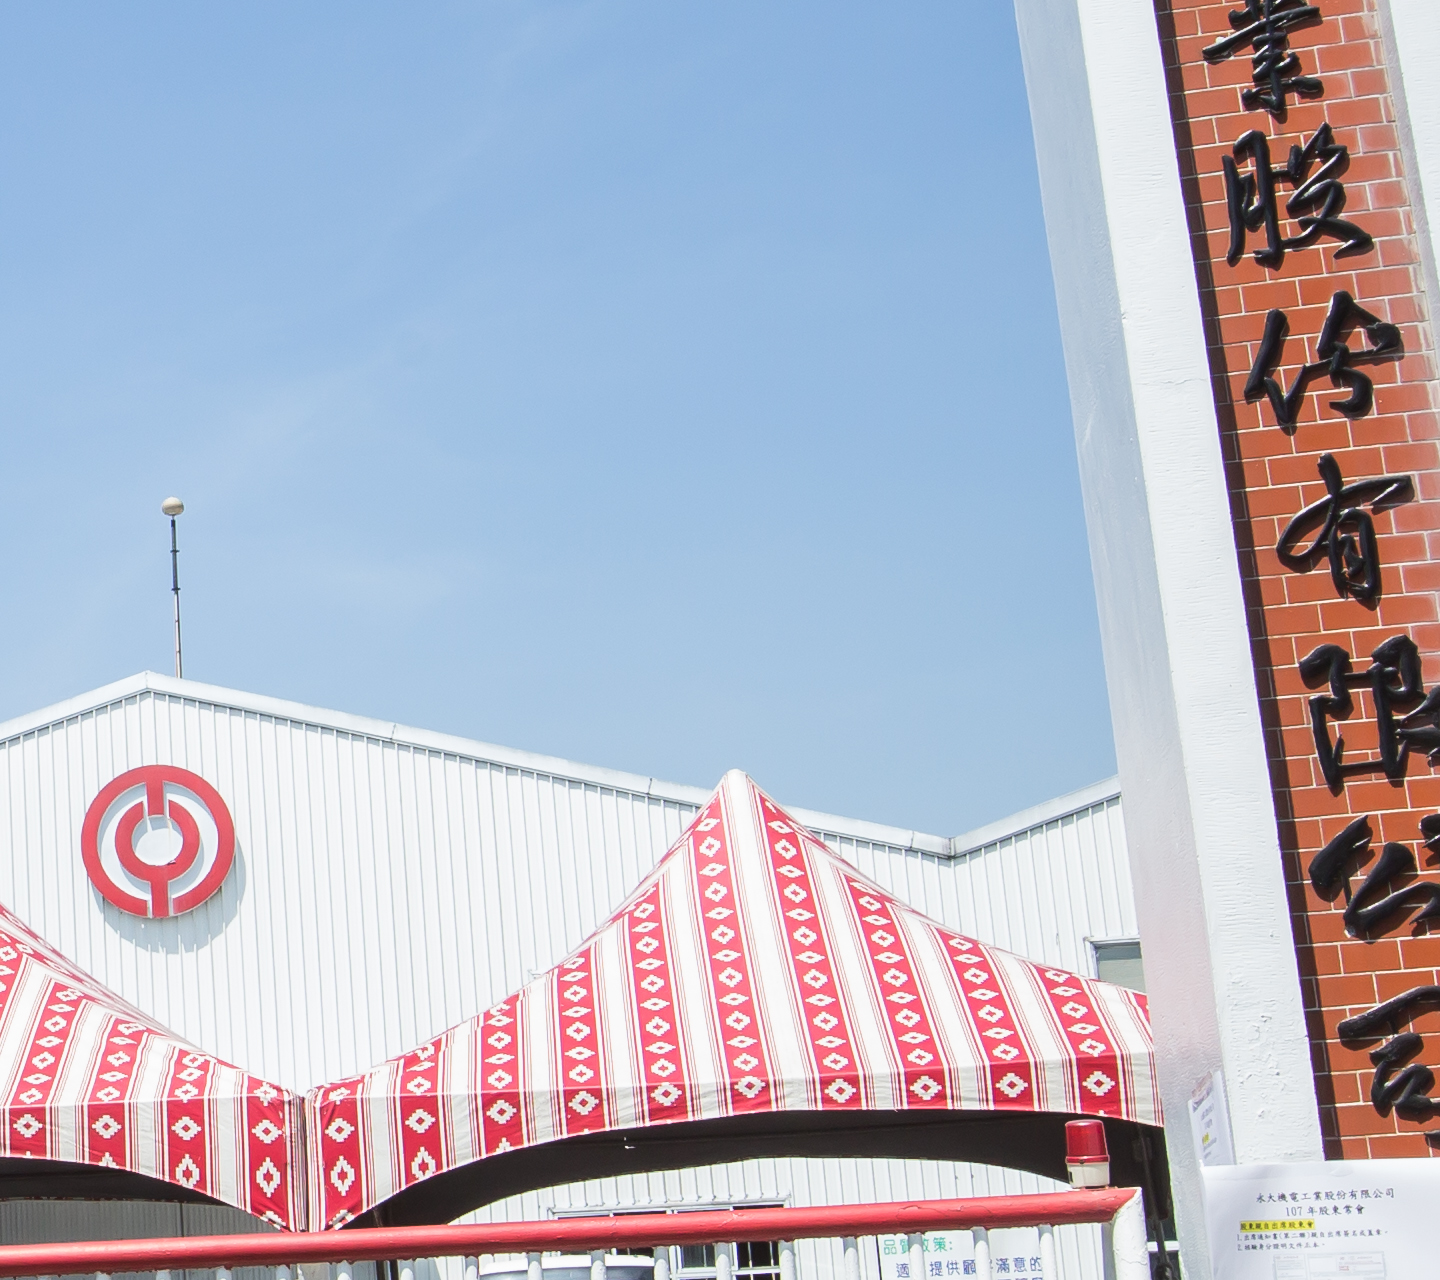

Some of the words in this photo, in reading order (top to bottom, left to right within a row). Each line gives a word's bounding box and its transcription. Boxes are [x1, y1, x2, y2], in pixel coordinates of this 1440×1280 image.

[1256, 1187, 1395, 1204] 永大機電工業股份有限公司
